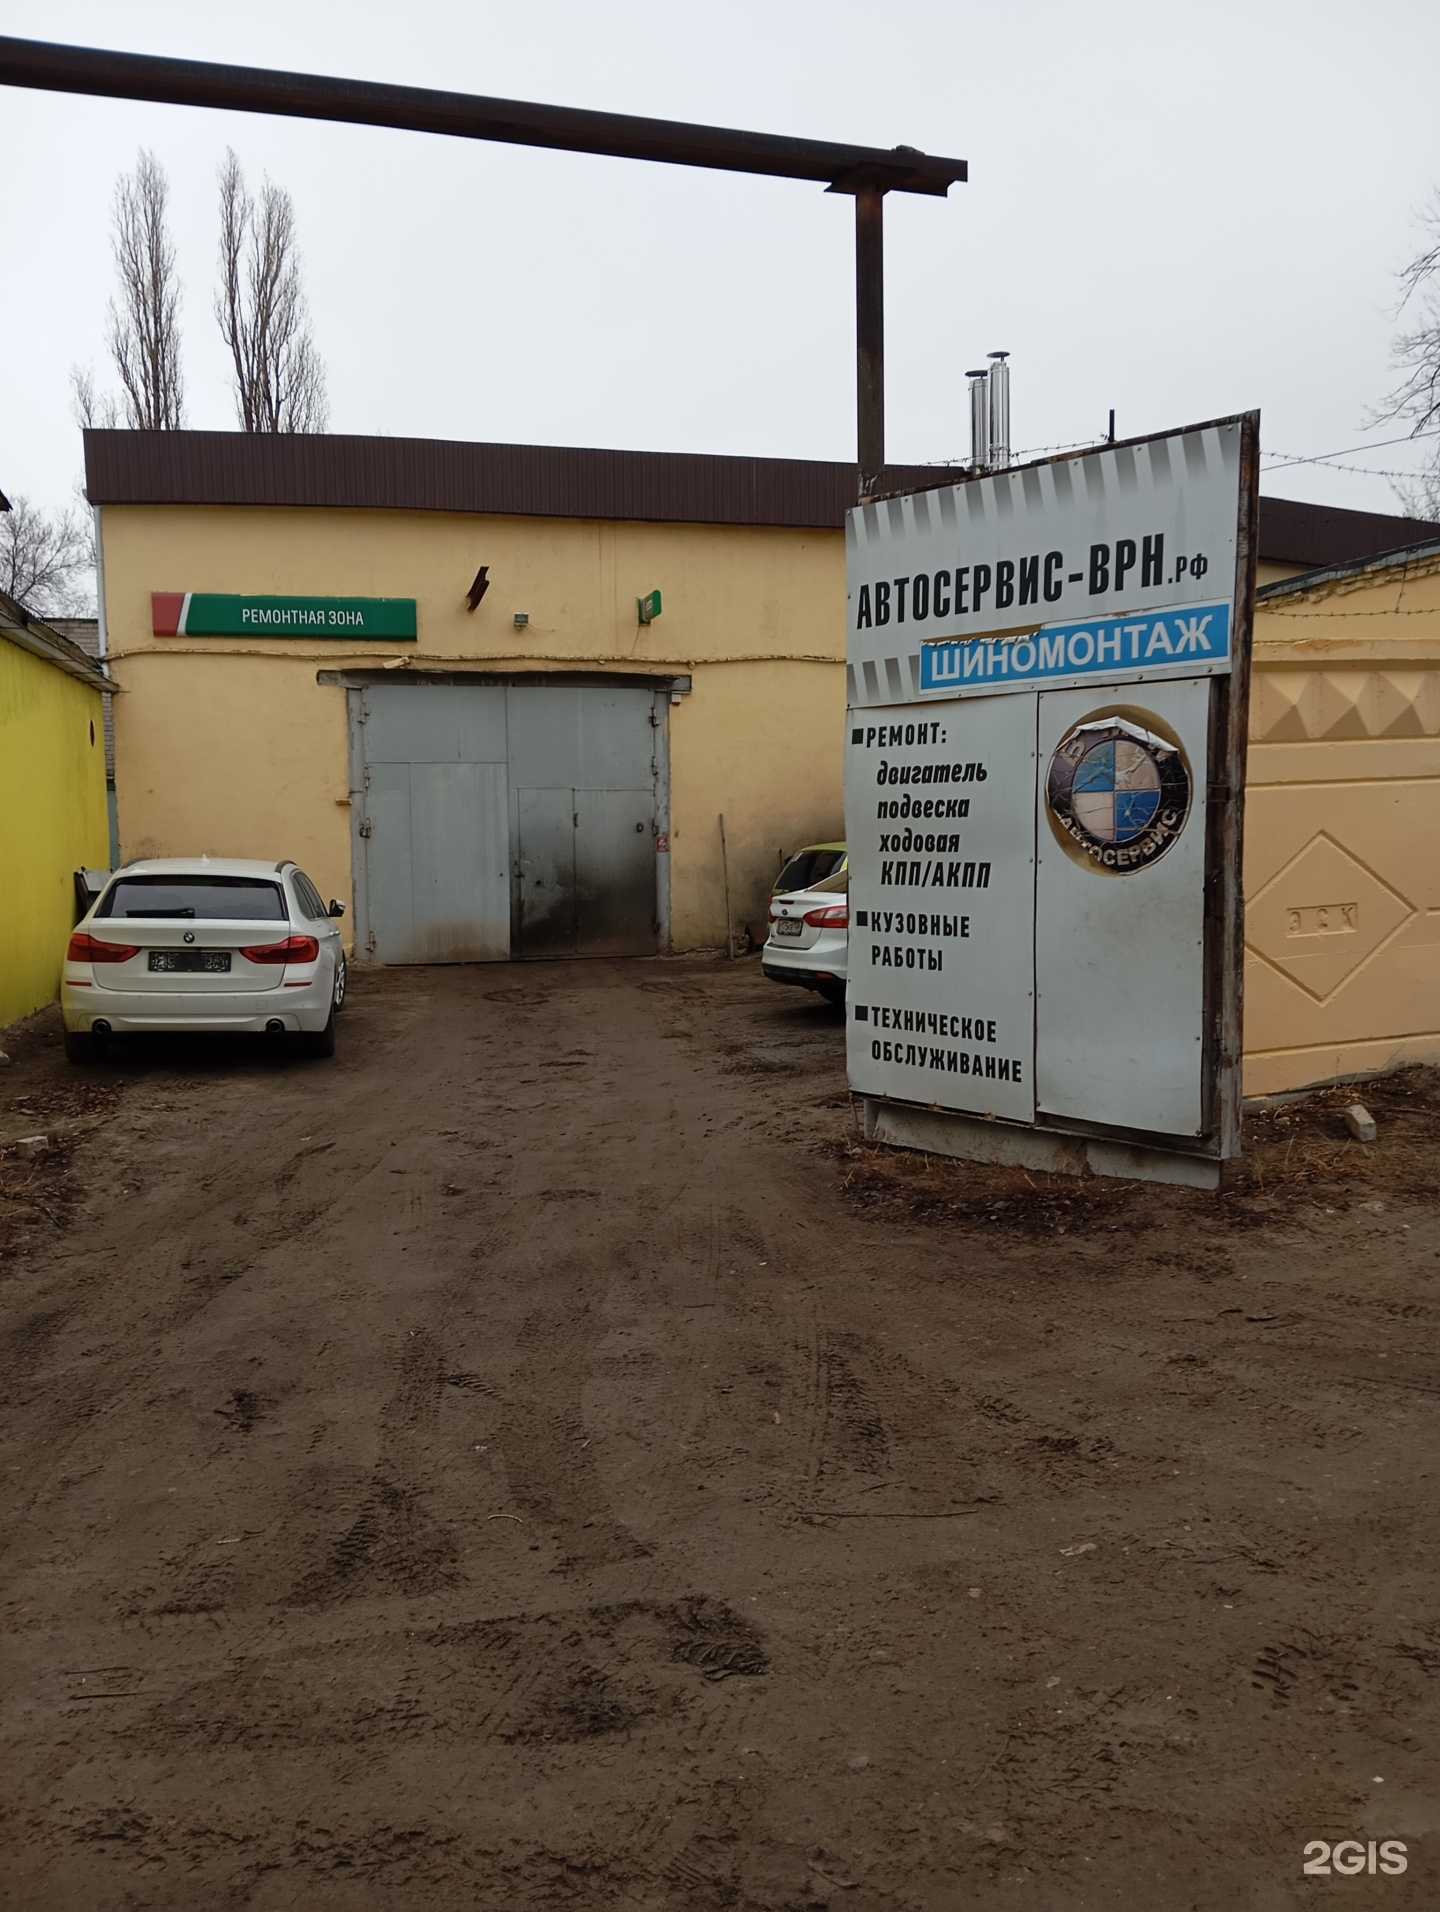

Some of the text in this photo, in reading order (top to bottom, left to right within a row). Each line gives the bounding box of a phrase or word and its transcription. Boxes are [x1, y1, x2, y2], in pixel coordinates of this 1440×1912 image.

[242, 608, 364, 626] РЕМОНТНАЯ ЗОНА
[931, 614, 1213, 681] ШИНОМОНТАЖ
[866, 722, 947, 748] РЕМОНТ:
[877, 760, 988, 785] двигатель
[877, 793, 970, 818] подвеска
[879, 827, 960, 852] ходовая
[880, 860, 991, 888] КПП/АКПП
[871, 911, 970, 937] КУЗОВНЫЕ
[871, 945, 943, 971] РАБОТЫ
[871, 1006, 997, 1042] ТЕХНИЧЕСКОЕ
[871, 1040, 1023, 1082] ОБСЛУЖИВАНИЕ
